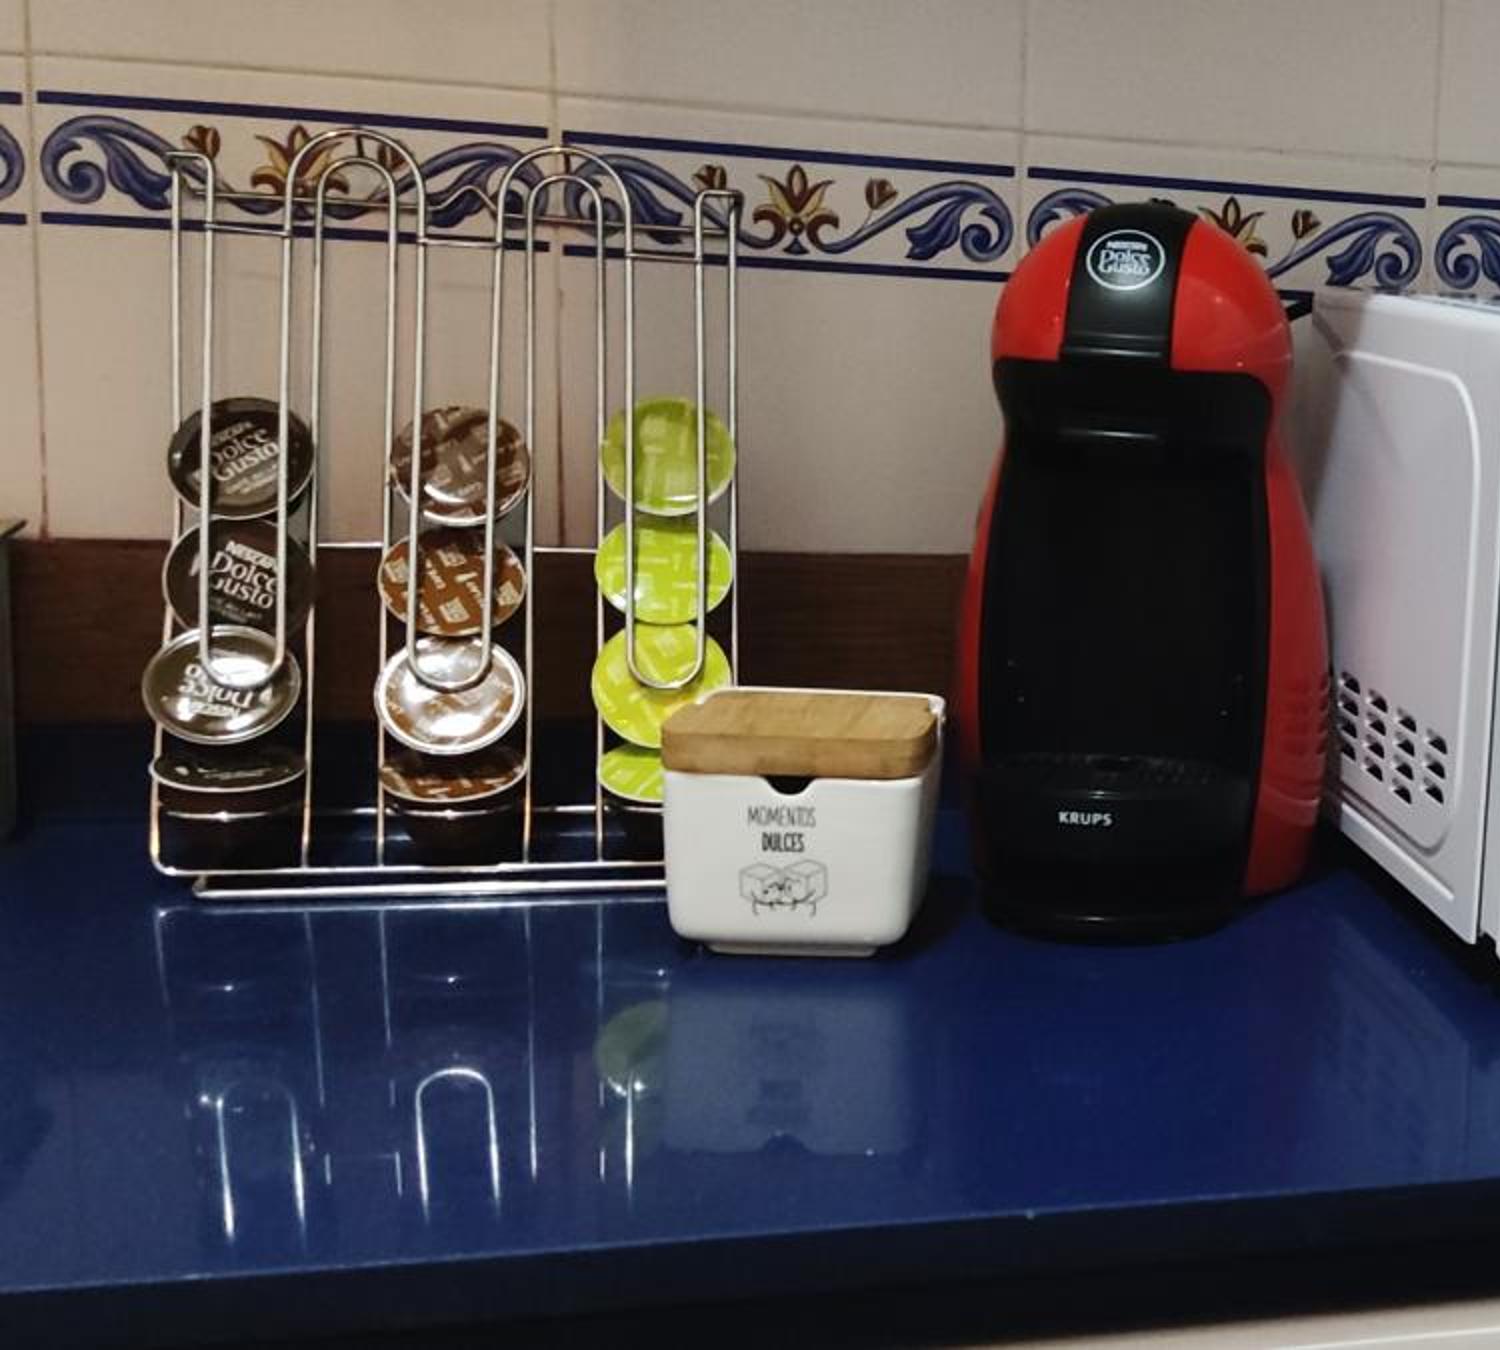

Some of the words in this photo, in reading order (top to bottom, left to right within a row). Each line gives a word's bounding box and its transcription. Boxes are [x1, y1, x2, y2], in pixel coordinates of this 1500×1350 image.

[212, 441, 280, 482] Gusto
[747, 805, 817, 828] MOMENTOS
[1058, 811, 1113, 826] KRUPS
[761, 832, 805, 854] DULCES
